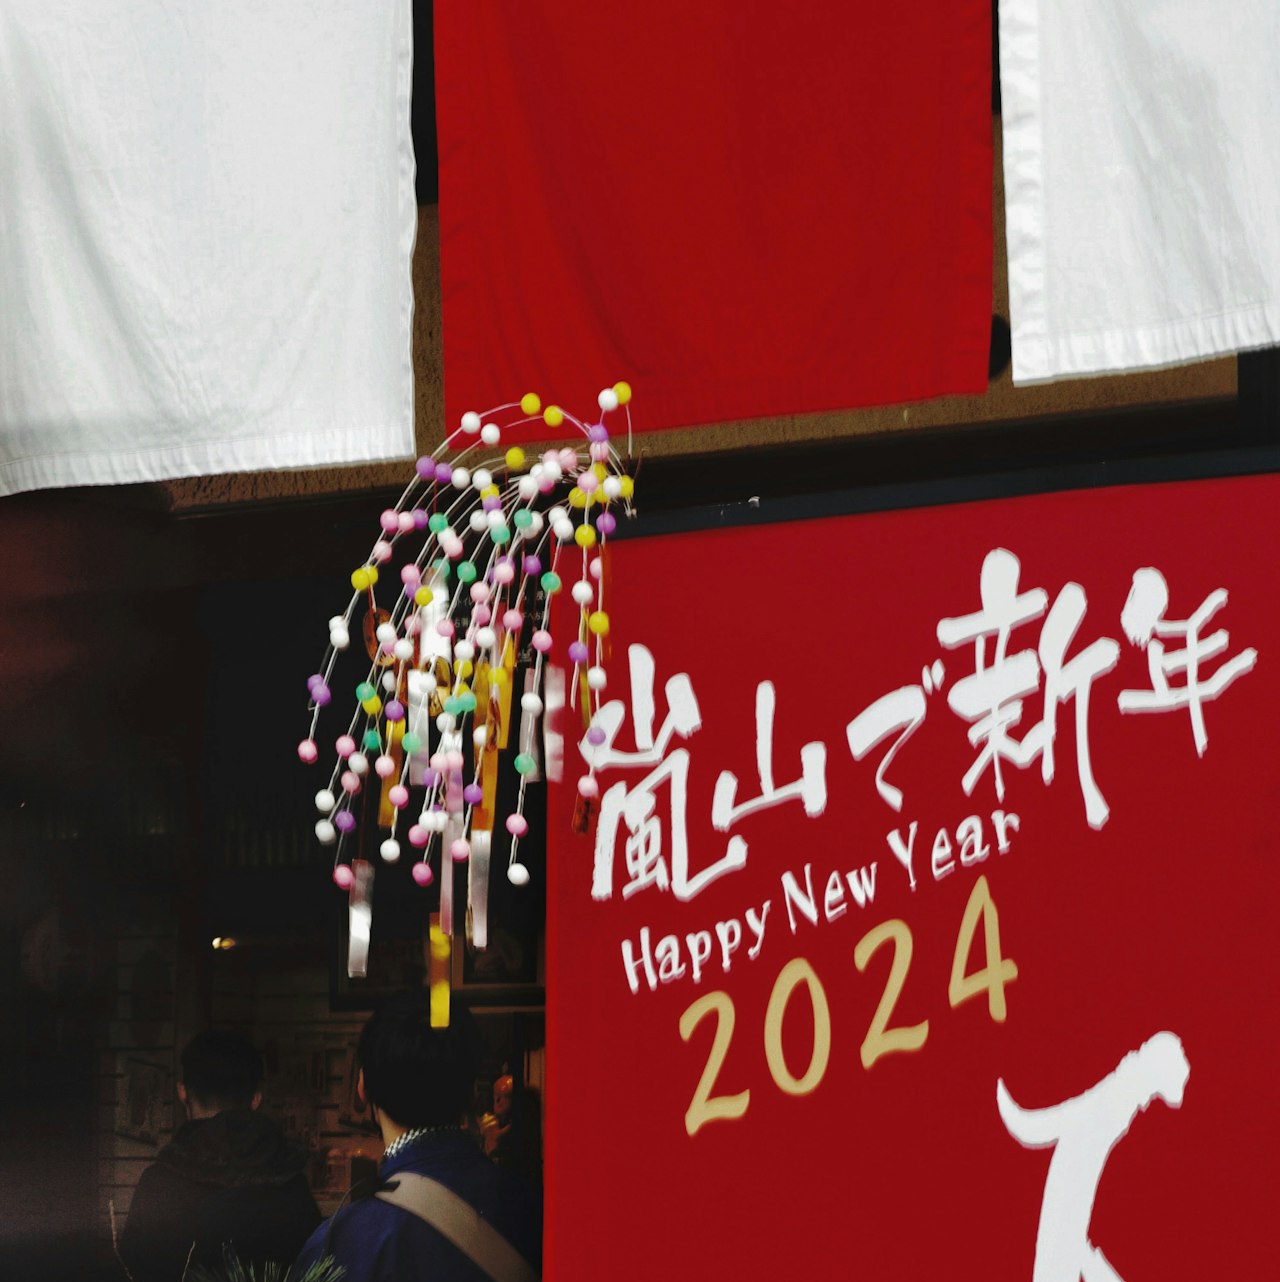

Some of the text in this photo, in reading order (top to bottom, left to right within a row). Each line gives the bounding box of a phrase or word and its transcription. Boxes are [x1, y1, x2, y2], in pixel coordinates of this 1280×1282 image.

[577, 546, 1259, 902] 嵐山で新年
[620, 808, 1021, 995] Happy New Year
[678, 875, 1020, 1137] 2024
